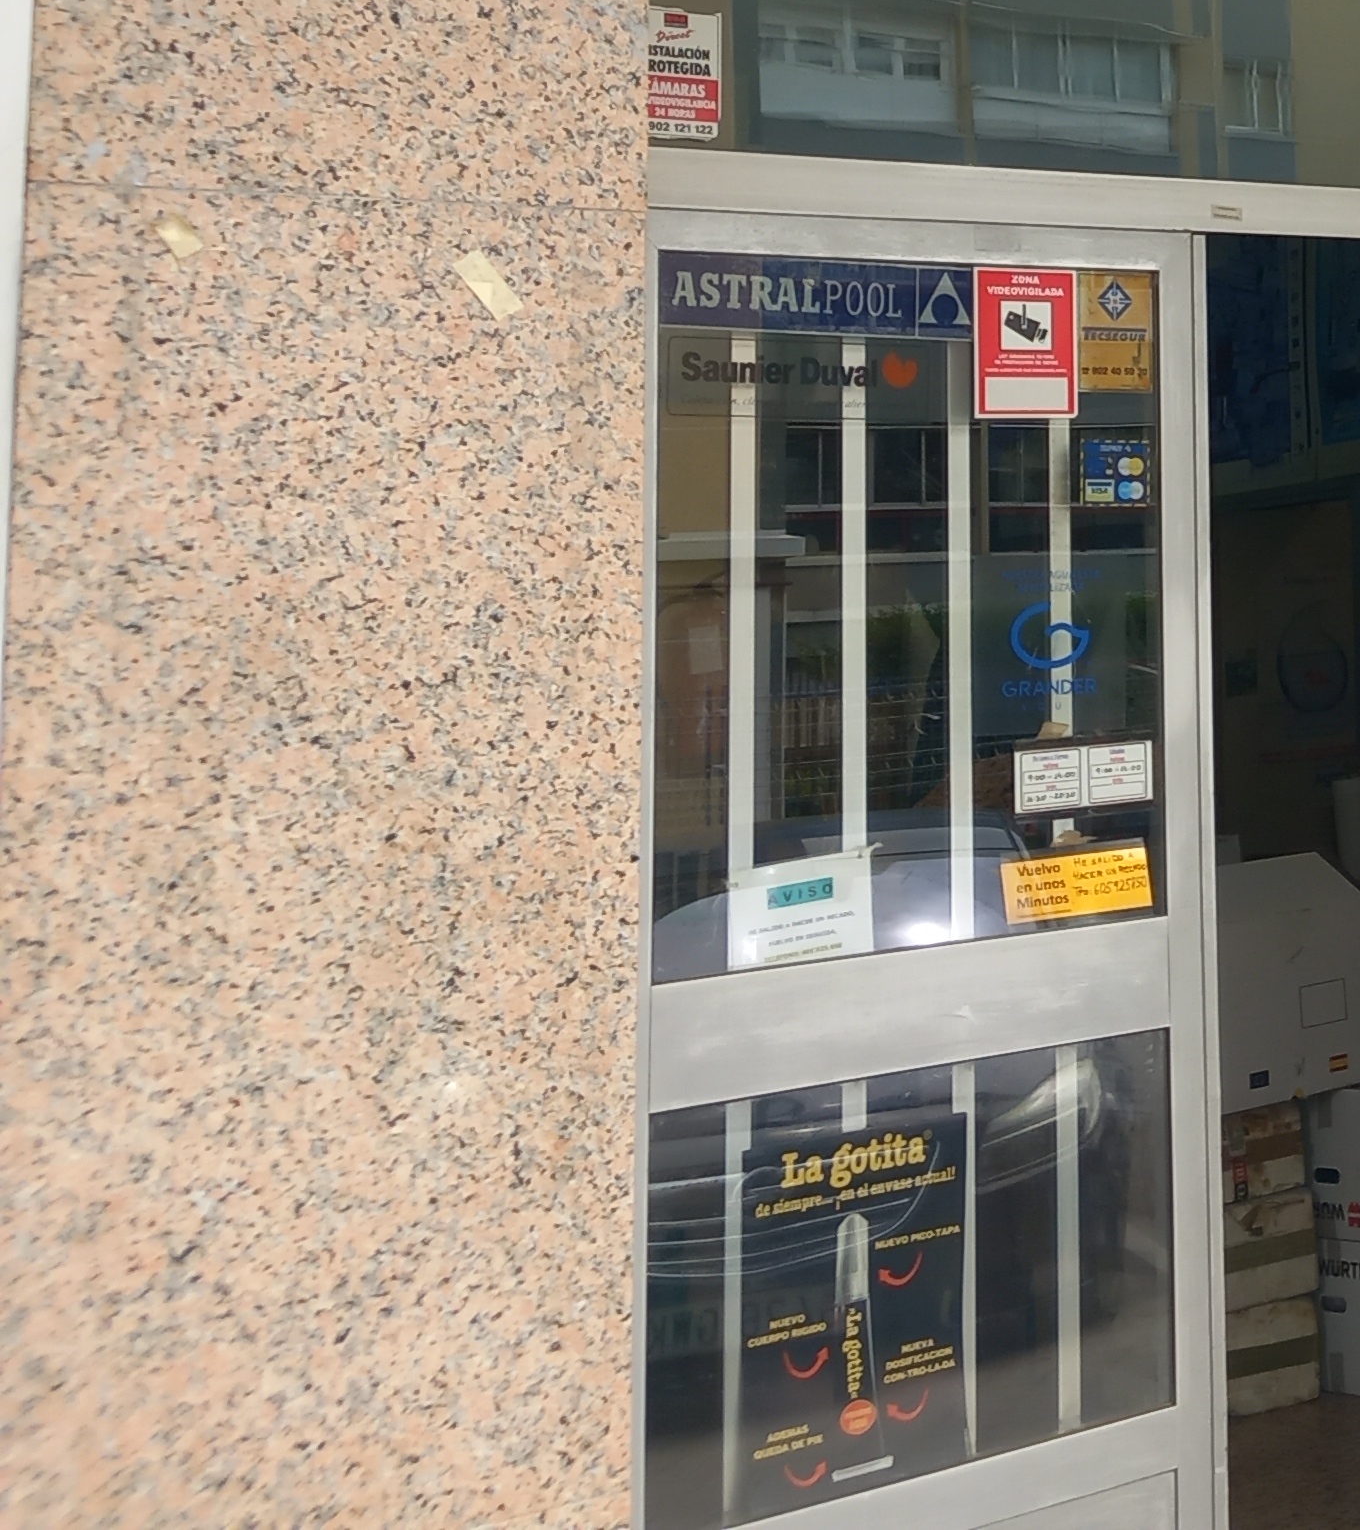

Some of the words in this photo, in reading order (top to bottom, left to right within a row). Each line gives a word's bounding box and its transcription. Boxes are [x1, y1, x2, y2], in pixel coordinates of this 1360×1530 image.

[648, 58, 712, 77] ROTEGIDA
[648, 77, 706, 98] ÁMARAS
[648, 120, 670, 132] 902
[1010, 274, 1041, 285] ZONA
[671, 270, 903, 319] ASTRALPOOL
[986, 285, 1065, 297] VIDEOVIGILADA
[681, 350, 796, 386] Saunier
[800, 355, 878, 388] Duval
[1001, 677, 1098, 698] GRANDER
[1016, 862, 1061, 877] Vuelvo
[767, 882, 833, 907] AVISO
[1016, 882, 1032, 894] en
[1035, 878, 1067, 890] unos
[1016, 893, 1070, 909] Minutos
[780, 1151, 825, 1189] La
[829, 1132, 927, 1189] gotita
[754, 1202, 771, 1219] de
[870, 1176, 913, 1196] envase
[874, 1234, 909, 1250] NUEVO
[768, 1313, 807, 1331] NUEVO
